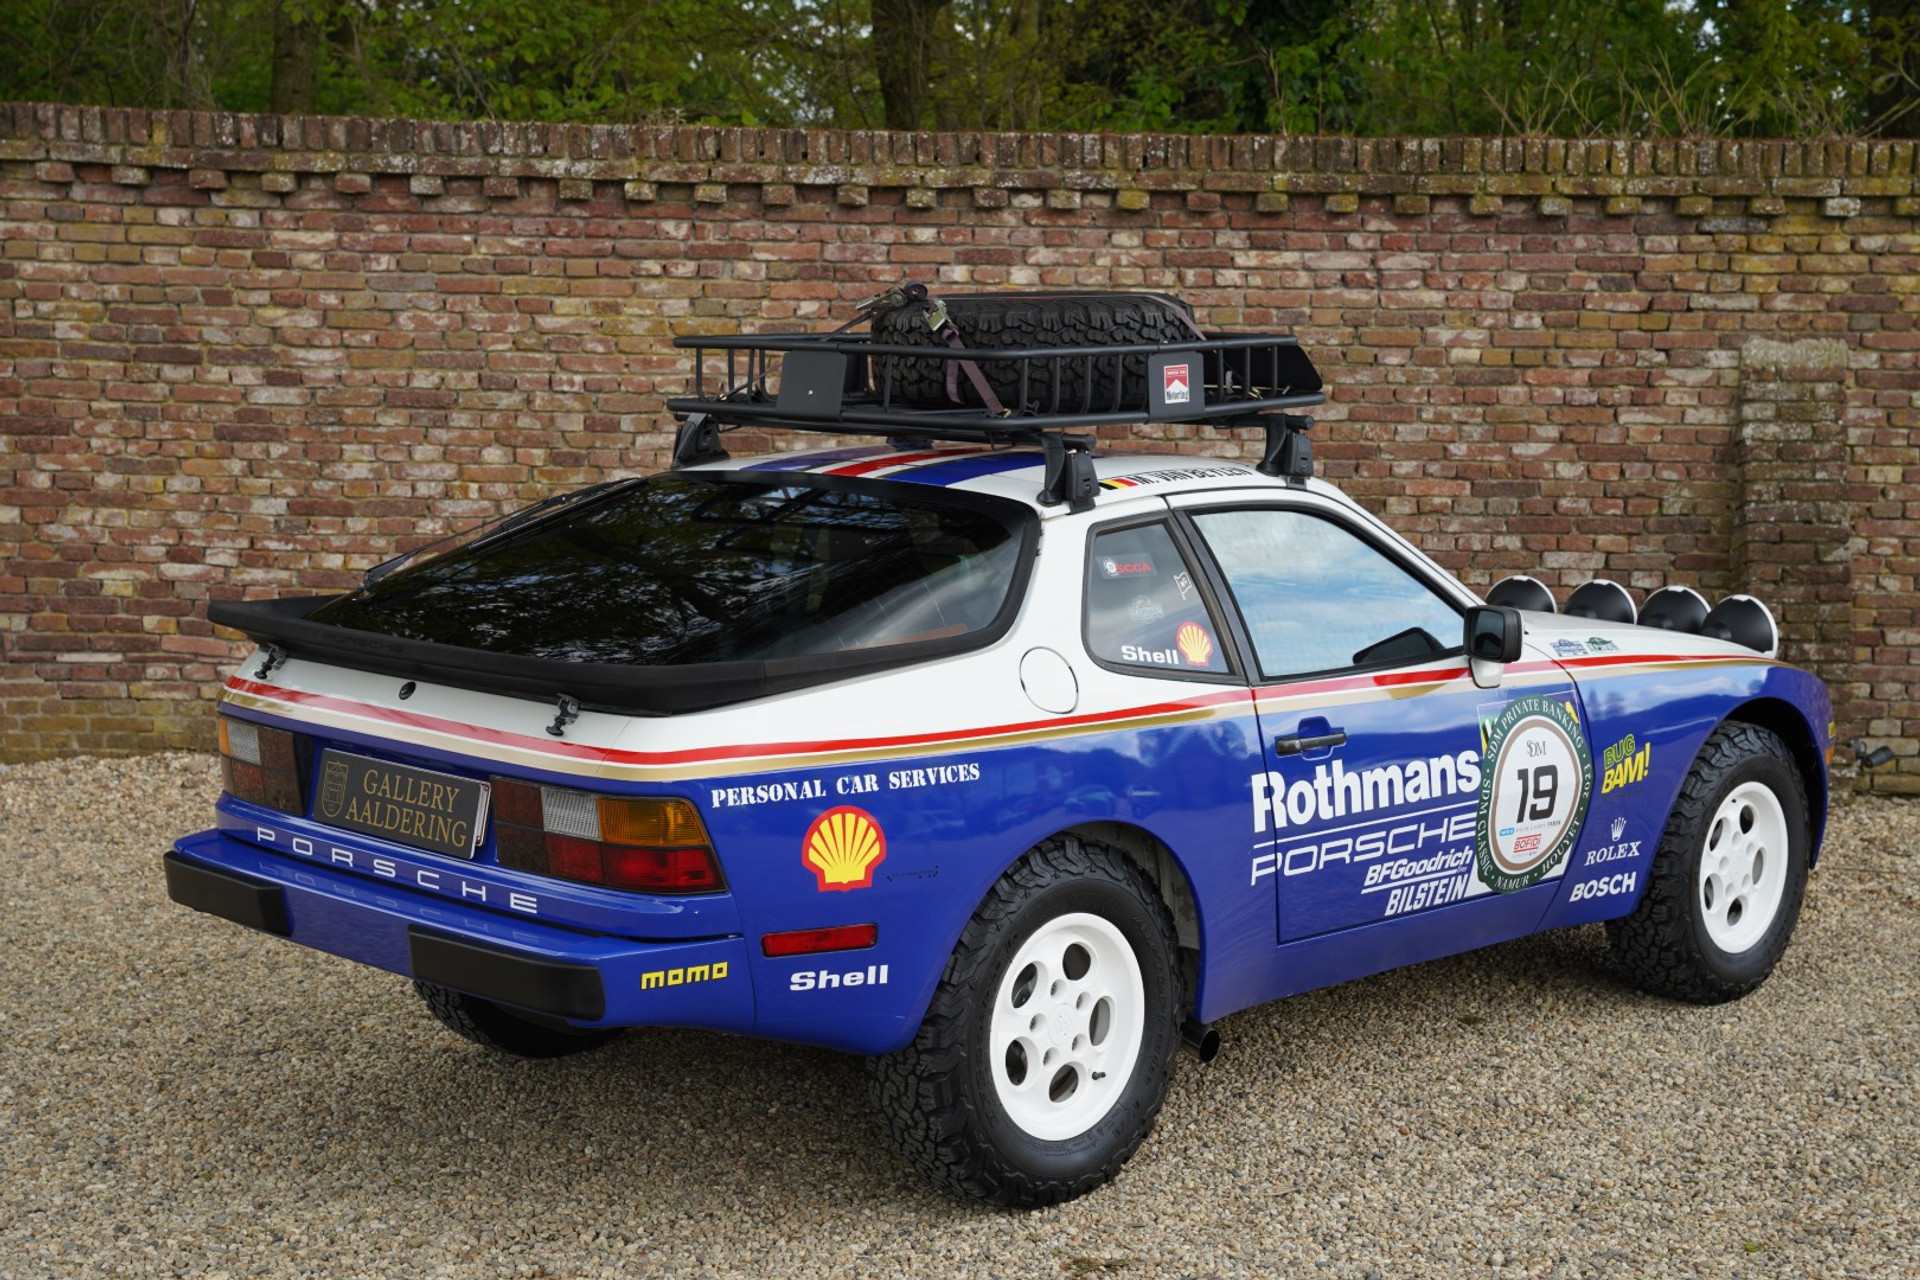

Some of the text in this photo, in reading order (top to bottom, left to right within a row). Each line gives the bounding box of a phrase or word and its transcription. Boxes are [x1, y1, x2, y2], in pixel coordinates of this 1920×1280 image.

[1116, 563, 1152, 573] SCCA
[1121, 645, 1179, 665] Shell
[1487, 698, 1583, 762] SDM PRIVATE BANKING
[1604, 733, 1635, 769] BUG
[711, 763, 980, 808] PERSONAL CAR SERVICES
[1583, 762, 1592, 799] 2023
[1601, 742, 1650, 794] BAM!
[363, 769, 460, 813] GALLERY
[1251, 750, 1481, 833] Rothmans
[1516, 765, 1558, 823] 19
[345, 796, 468, 847] AALDERING
[1477, 778, 1494, 876] SDM CLASSIC
[1251, 812, 1478, 887] PORSCHE
[1363, 846, 1473, 887] BFGoodrich
[1542, 819, 1580, 873] HOUYET
[1584, 841, 1641, 866] ROLEX
[257, 827, 538, 914] PORSCHE
[1495, 875, 1530, 891] NAMUR
[1569, 871, 1637, 902] BOSCH
[1384, 874, 1471, 916] BILSTEIN
[641, 961, 729, 990] momo
[789, 965, 889, 991] Shell
